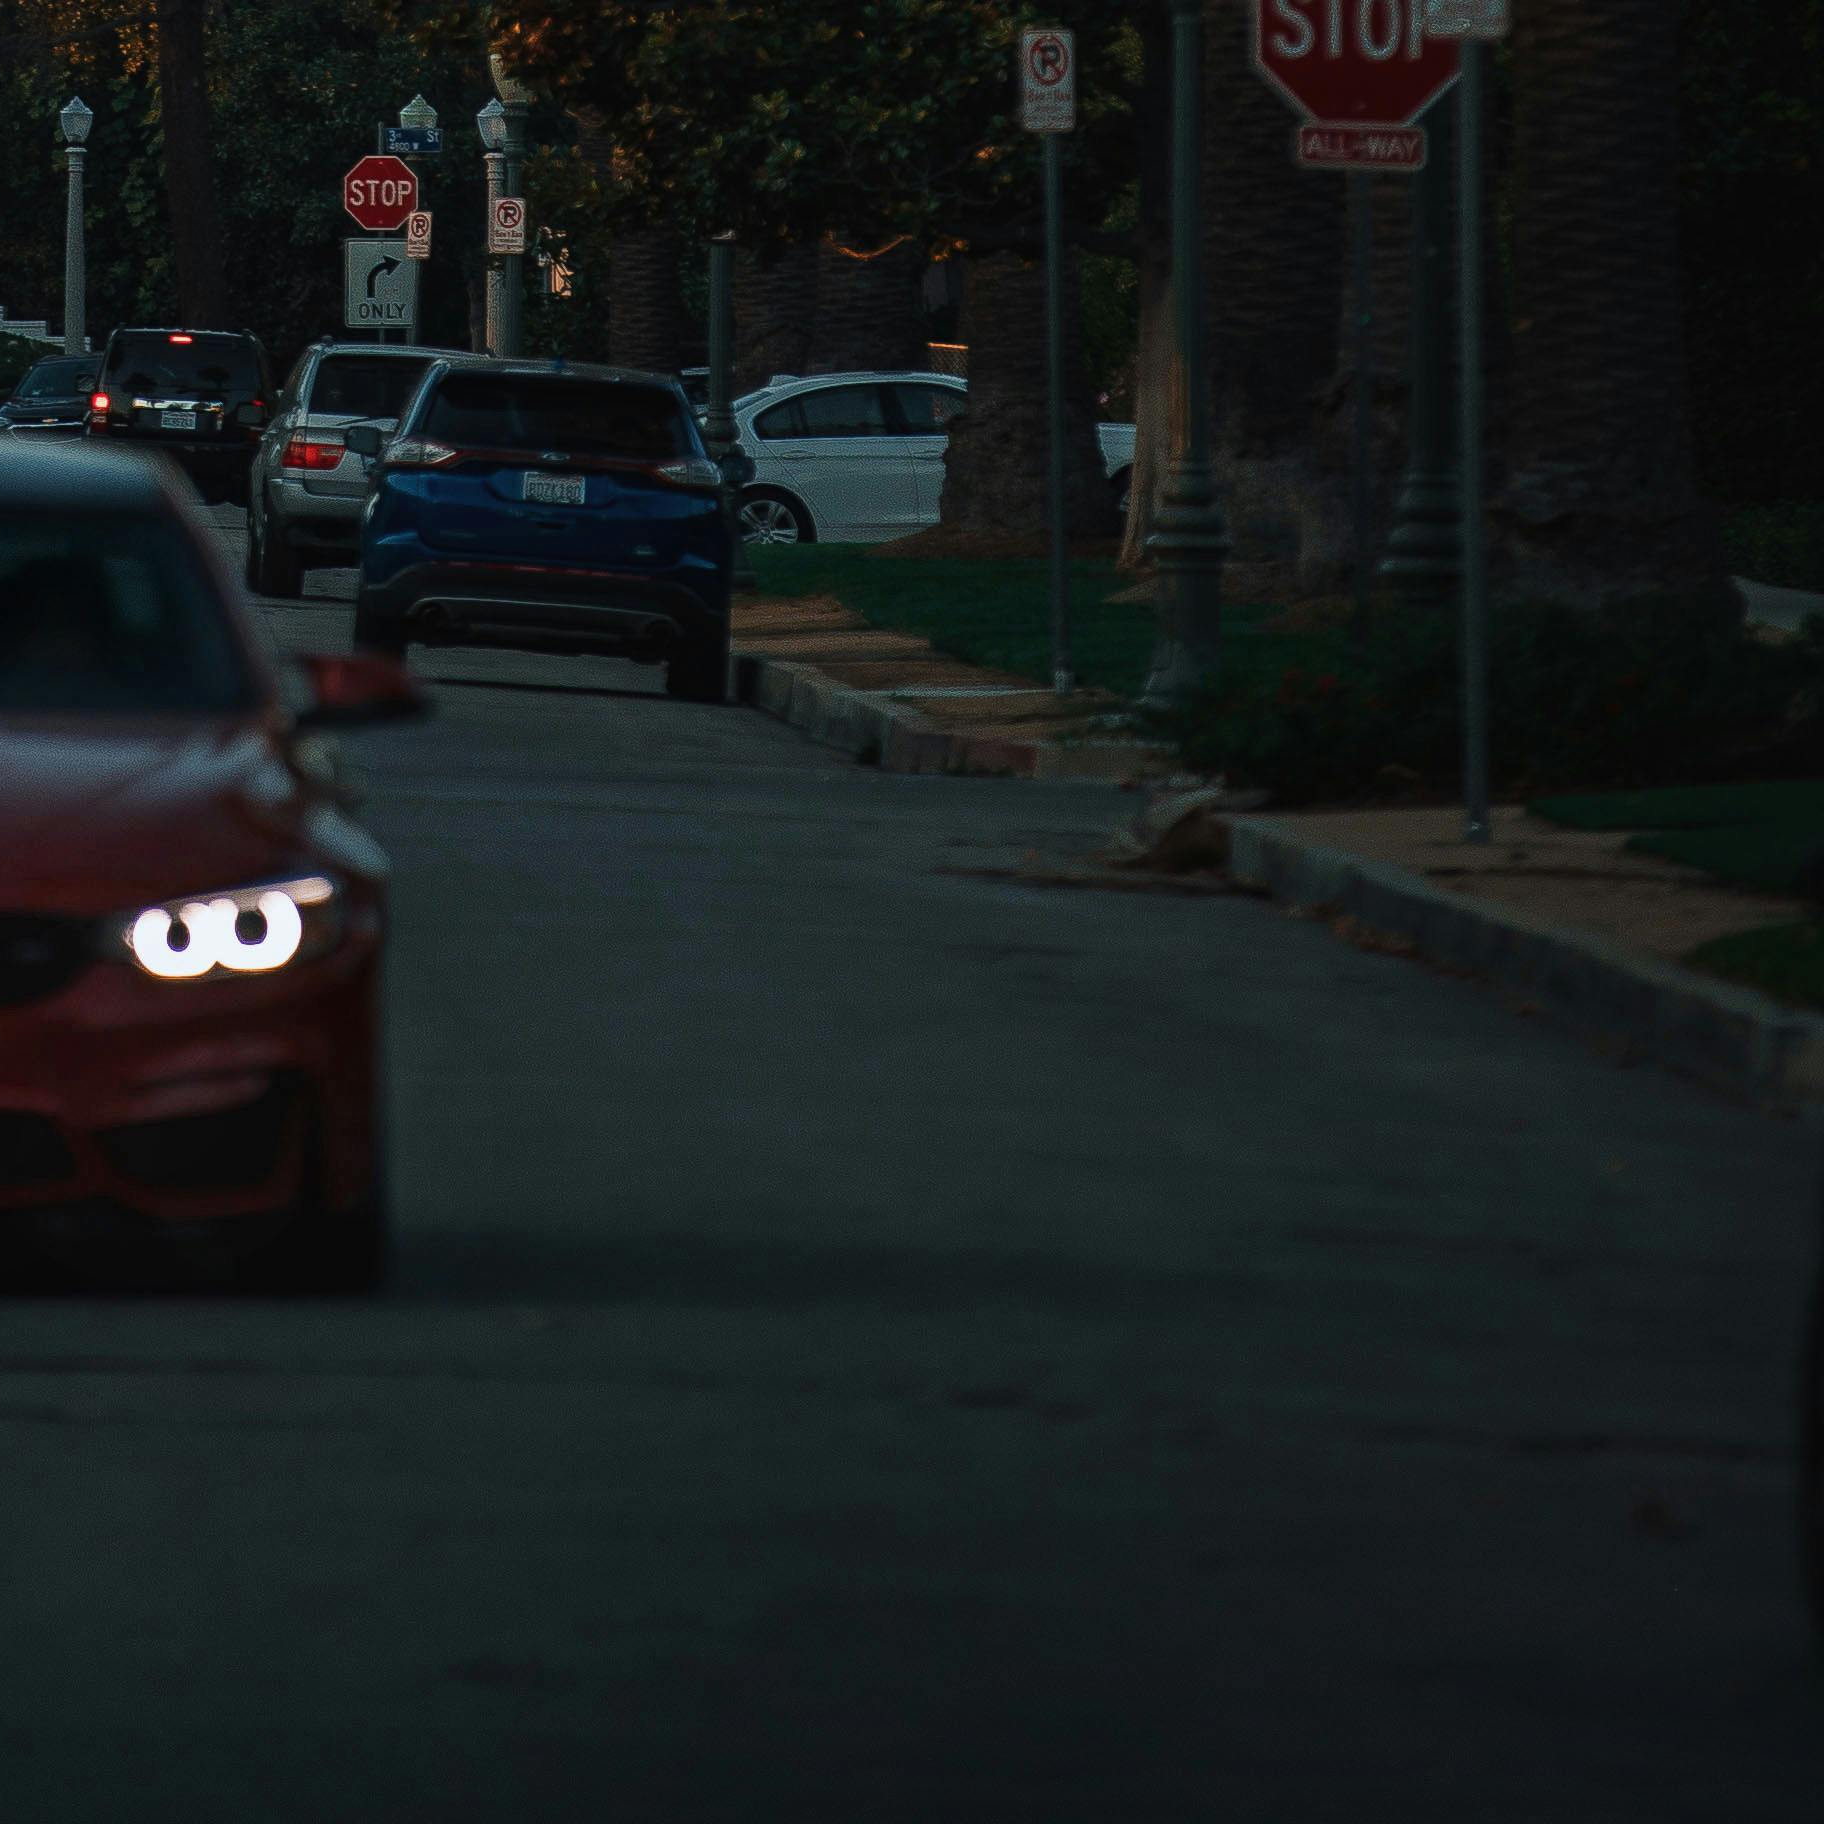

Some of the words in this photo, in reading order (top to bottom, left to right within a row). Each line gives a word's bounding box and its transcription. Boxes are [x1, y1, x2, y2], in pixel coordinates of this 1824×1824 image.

[426, 130, 440, 143] St
[350, 179, 413, 207] STOP
[358, 302, 407, 320] ONLY
